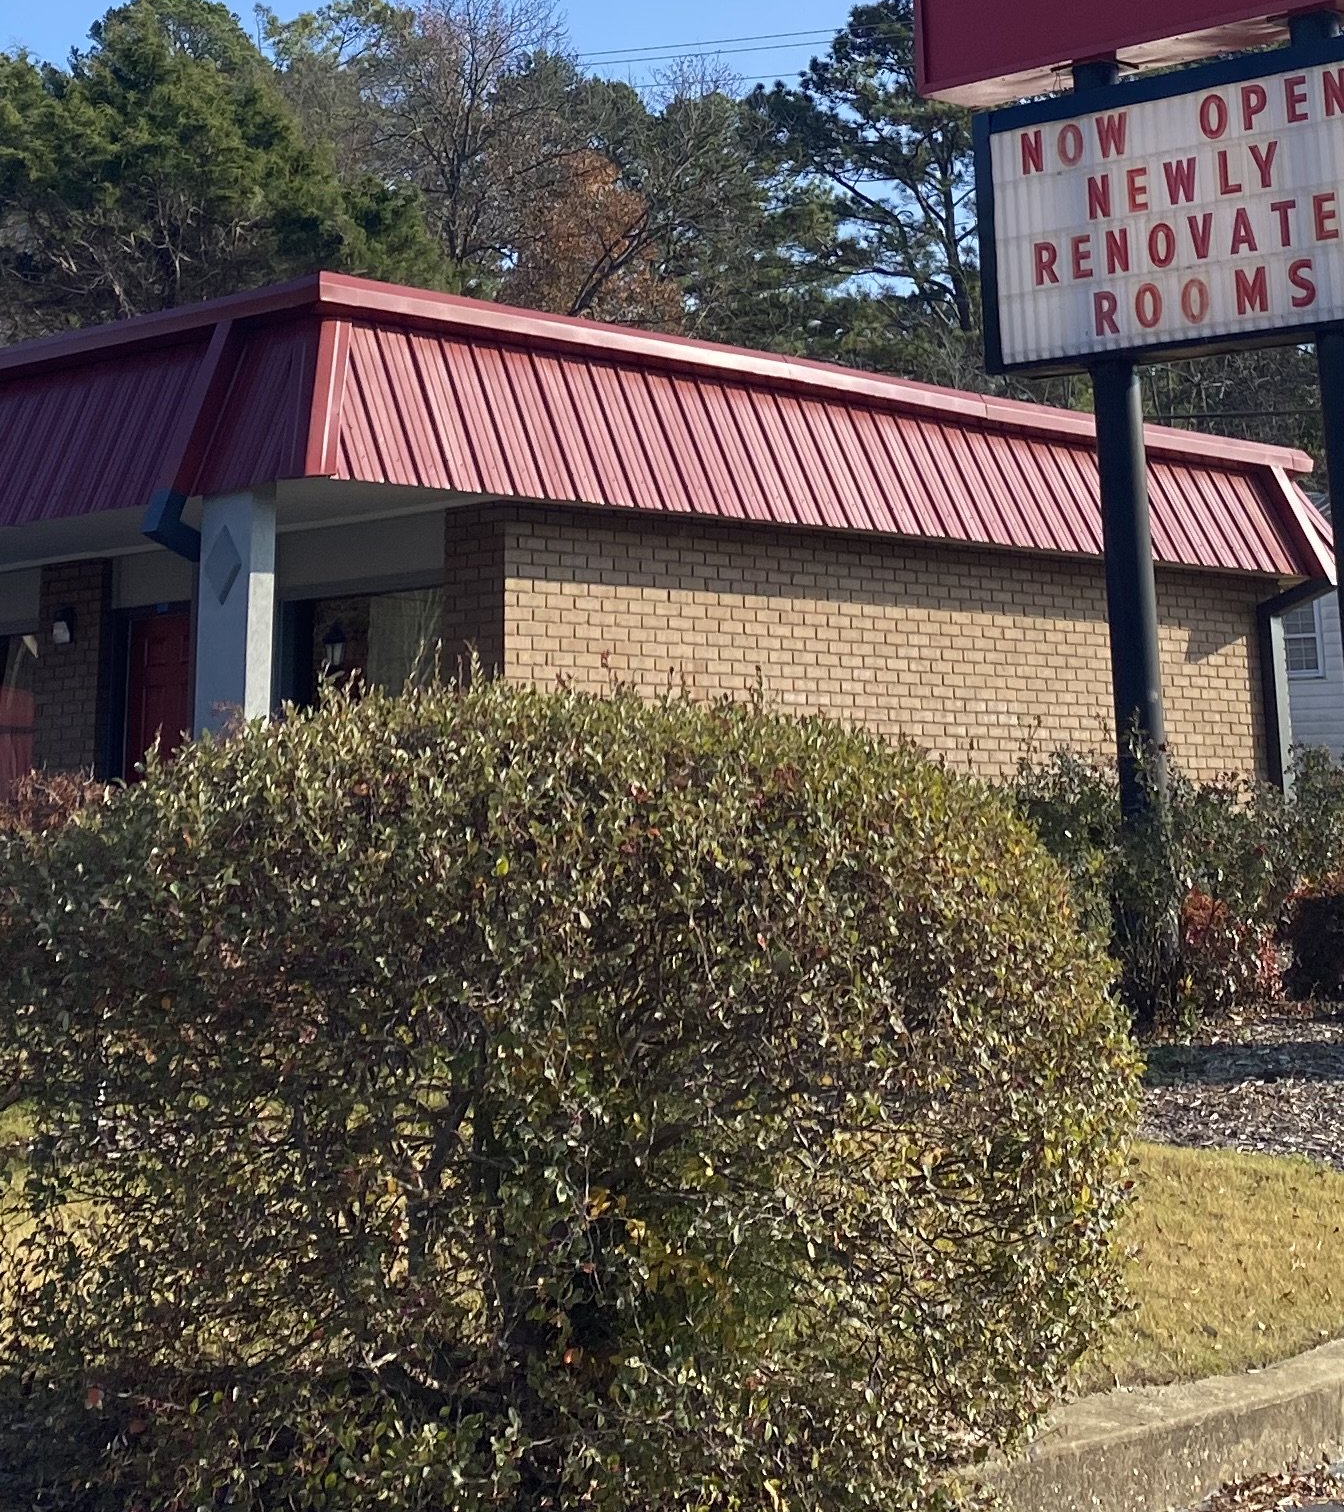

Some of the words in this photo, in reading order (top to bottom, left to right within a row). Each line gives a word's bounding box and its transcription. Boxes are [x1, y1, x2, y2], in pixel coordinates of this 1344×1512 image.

[1020, 111, 1128, 175] NOW
[1087, 141, 1279, 220] NEWLY
[1093, 258, 1317, 337] ROOMS
